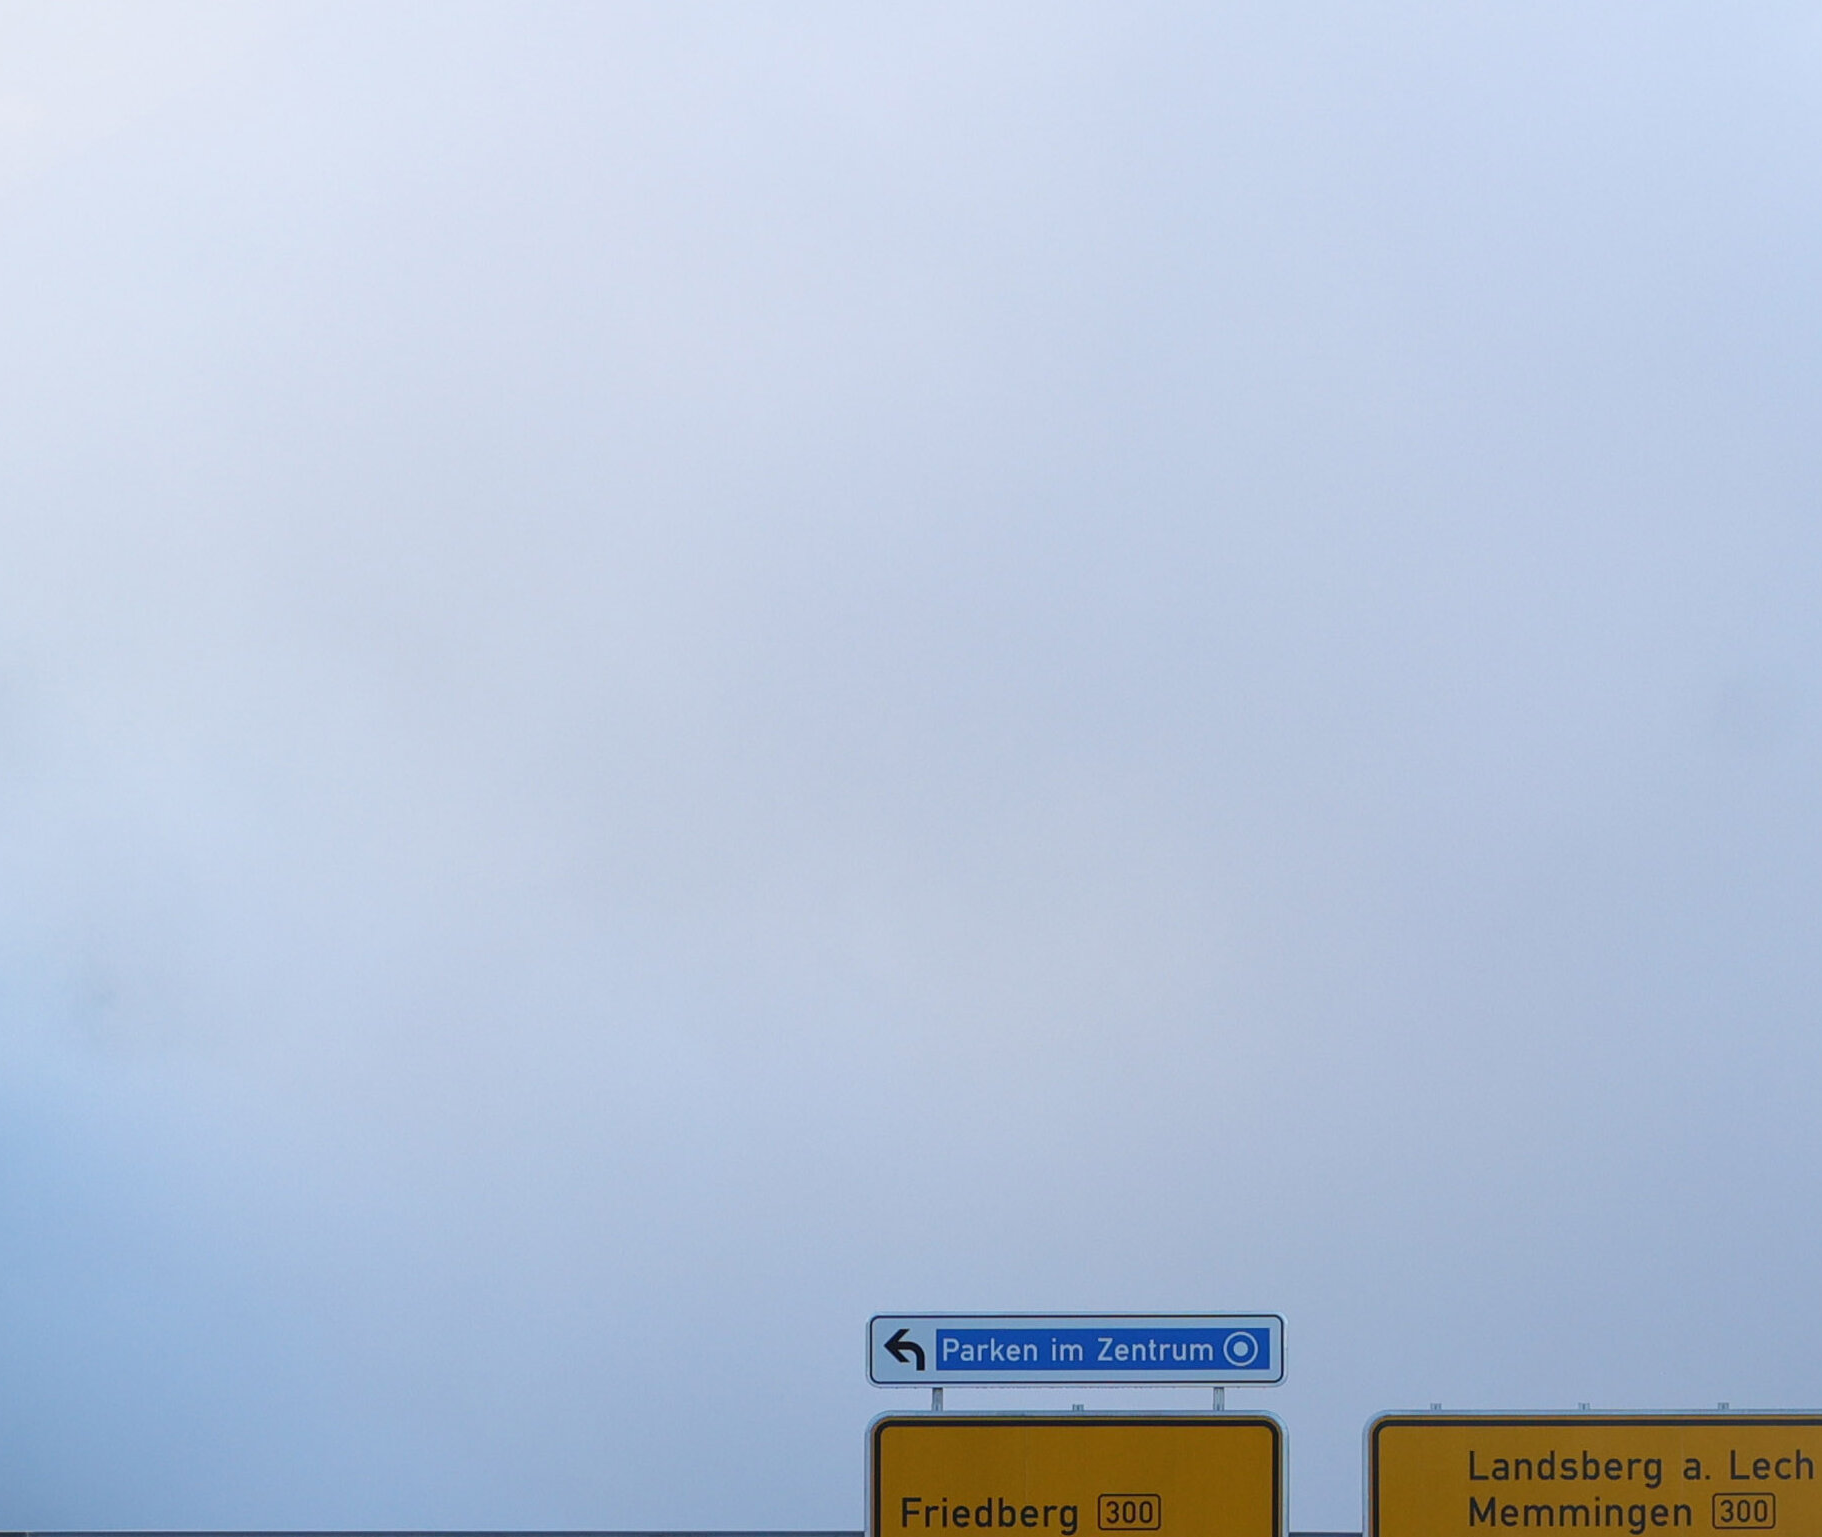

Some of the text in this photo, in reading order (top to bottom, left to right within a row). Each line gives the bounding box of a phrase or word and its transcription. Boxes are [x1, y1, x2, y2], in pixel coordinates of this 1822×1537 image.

[943, 1338, 1213, 1361] Parken im Zentrum
[1470, 1449, 1813, 1489] Landsberg a. Lech
[902, 1497, 1077, 1536] Friedberg
[1107, 1501, 1153, 1524] 300
[1470, 1496, 1691, 1535] Memmingen
[1721, 1500, 1767, 1523] 300
